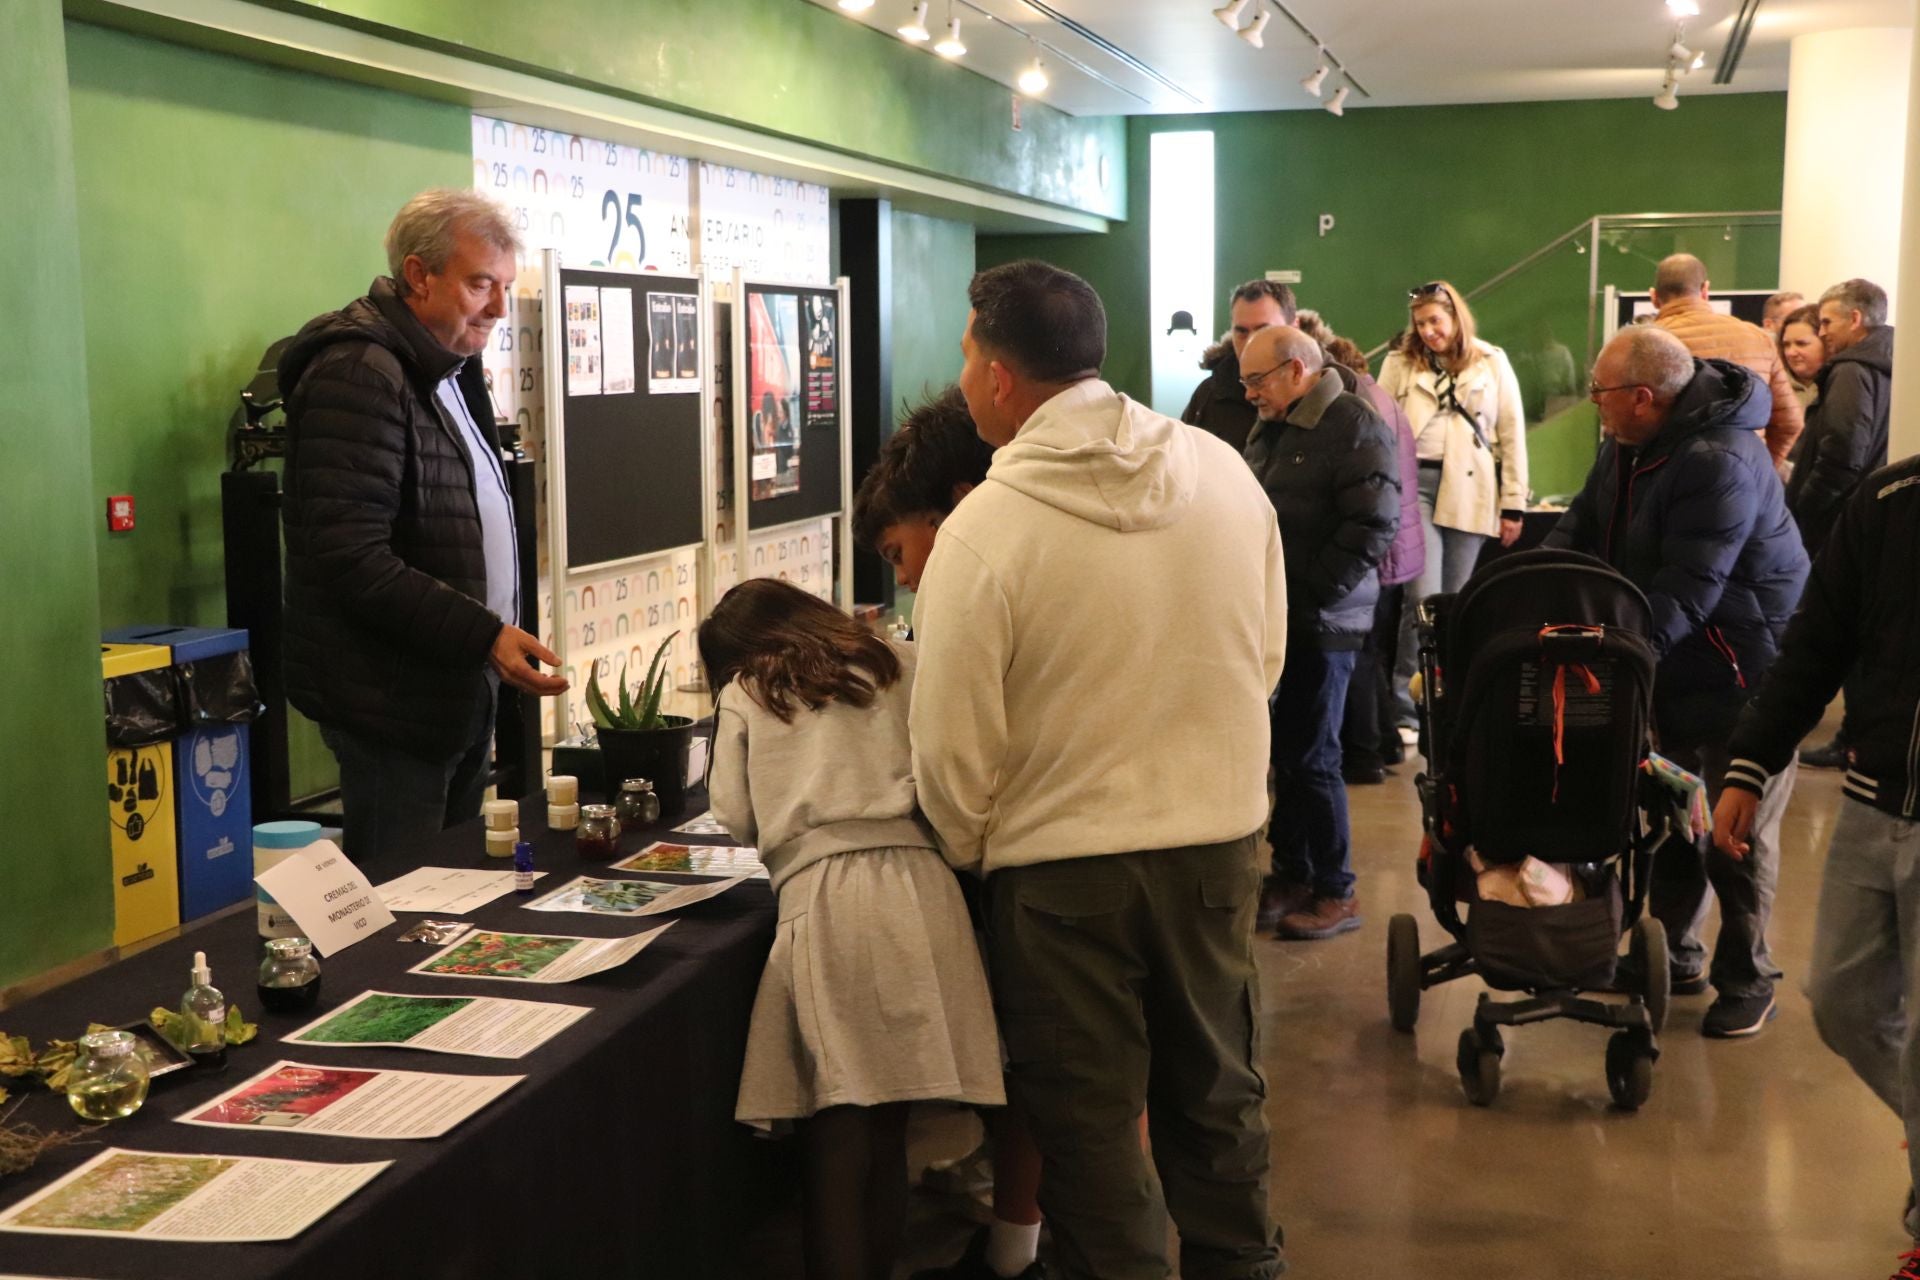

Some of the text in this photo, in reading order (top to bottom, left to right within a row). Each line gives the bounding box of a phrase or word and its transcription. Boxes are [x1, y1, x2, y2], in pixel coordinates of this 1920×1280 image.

[532, 127, 546, 153] 25
[605, 143, 618, 166] 25
[493, 162, 508, 187] 25
[571, 175, 584, 199] 25
[515, 206, 529, 231] 25
[601, 189, 646, 264] 25
[1319, 213, 1335, 237] P
[671, 215, 763, 248] ANERSARIO
[499, 327, 514, 351] 25
[520, 368, 534, 392] 25
[677, 564, 688, 585] 25
[616, 578, 628, 601] 25
[649, 605, 660, 627] 25
[583, 622, 596, 647] 25
[599, 655, 610, 679] 25
[324, 885, 349, 903] CREMAS
[328, 898, 366, 923] MONASTERIO
[354, 917, 368, 930] VICO
